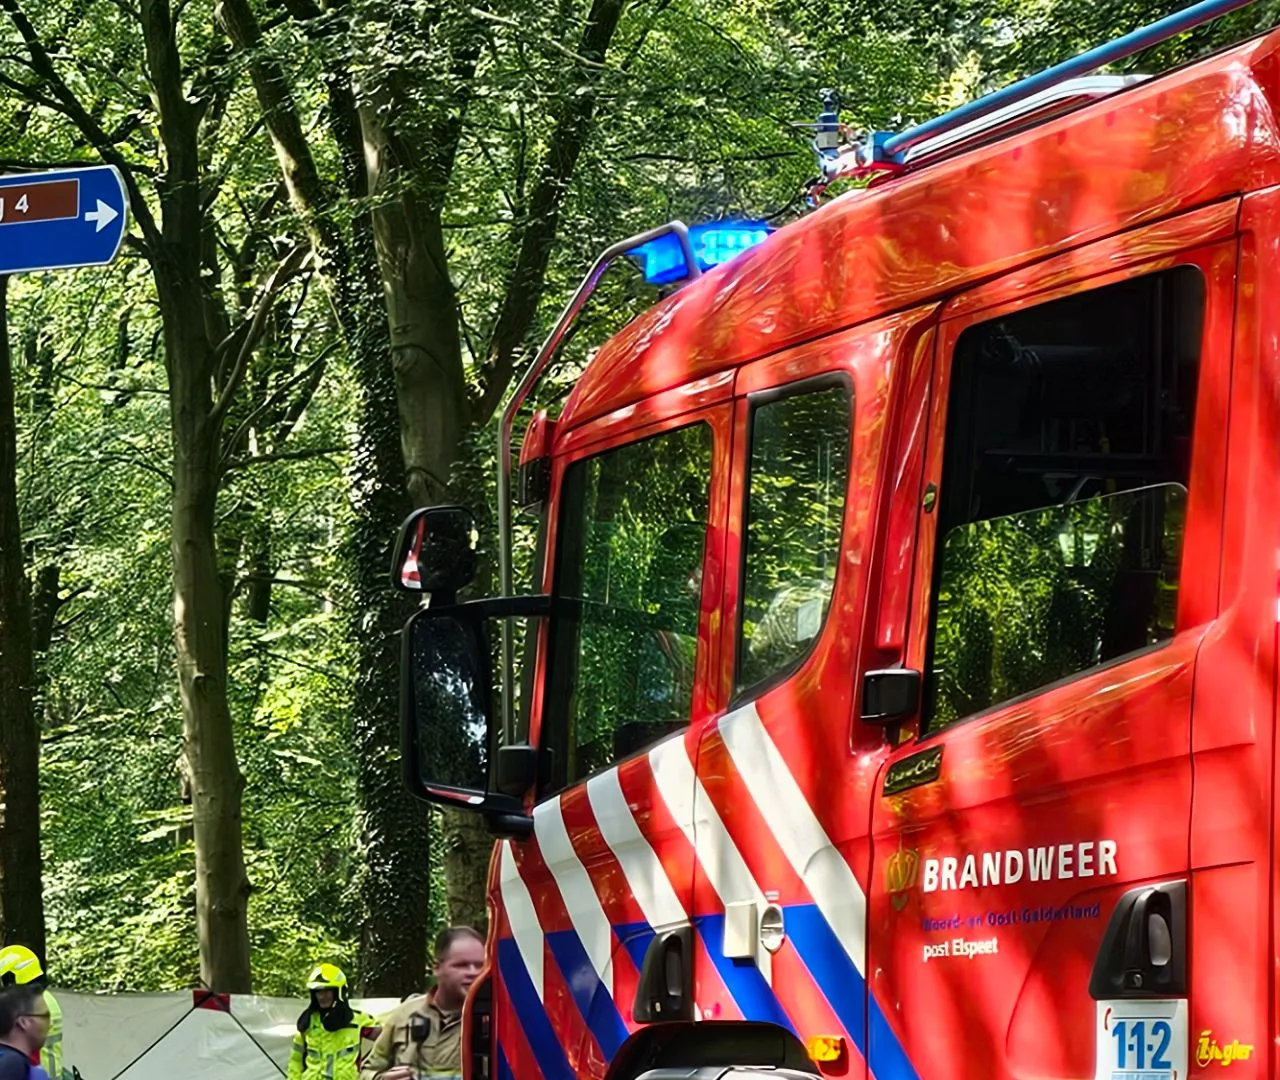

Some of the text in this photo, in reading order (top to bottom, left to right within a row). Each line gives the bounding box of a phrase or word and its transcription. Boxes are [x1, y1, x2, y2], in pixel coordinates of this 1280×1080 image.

[14, 194, 30, 214] 4
[923, 839, 1118, 893] BRANDWEER
[923, 936, 999, 964] post Elspeet
